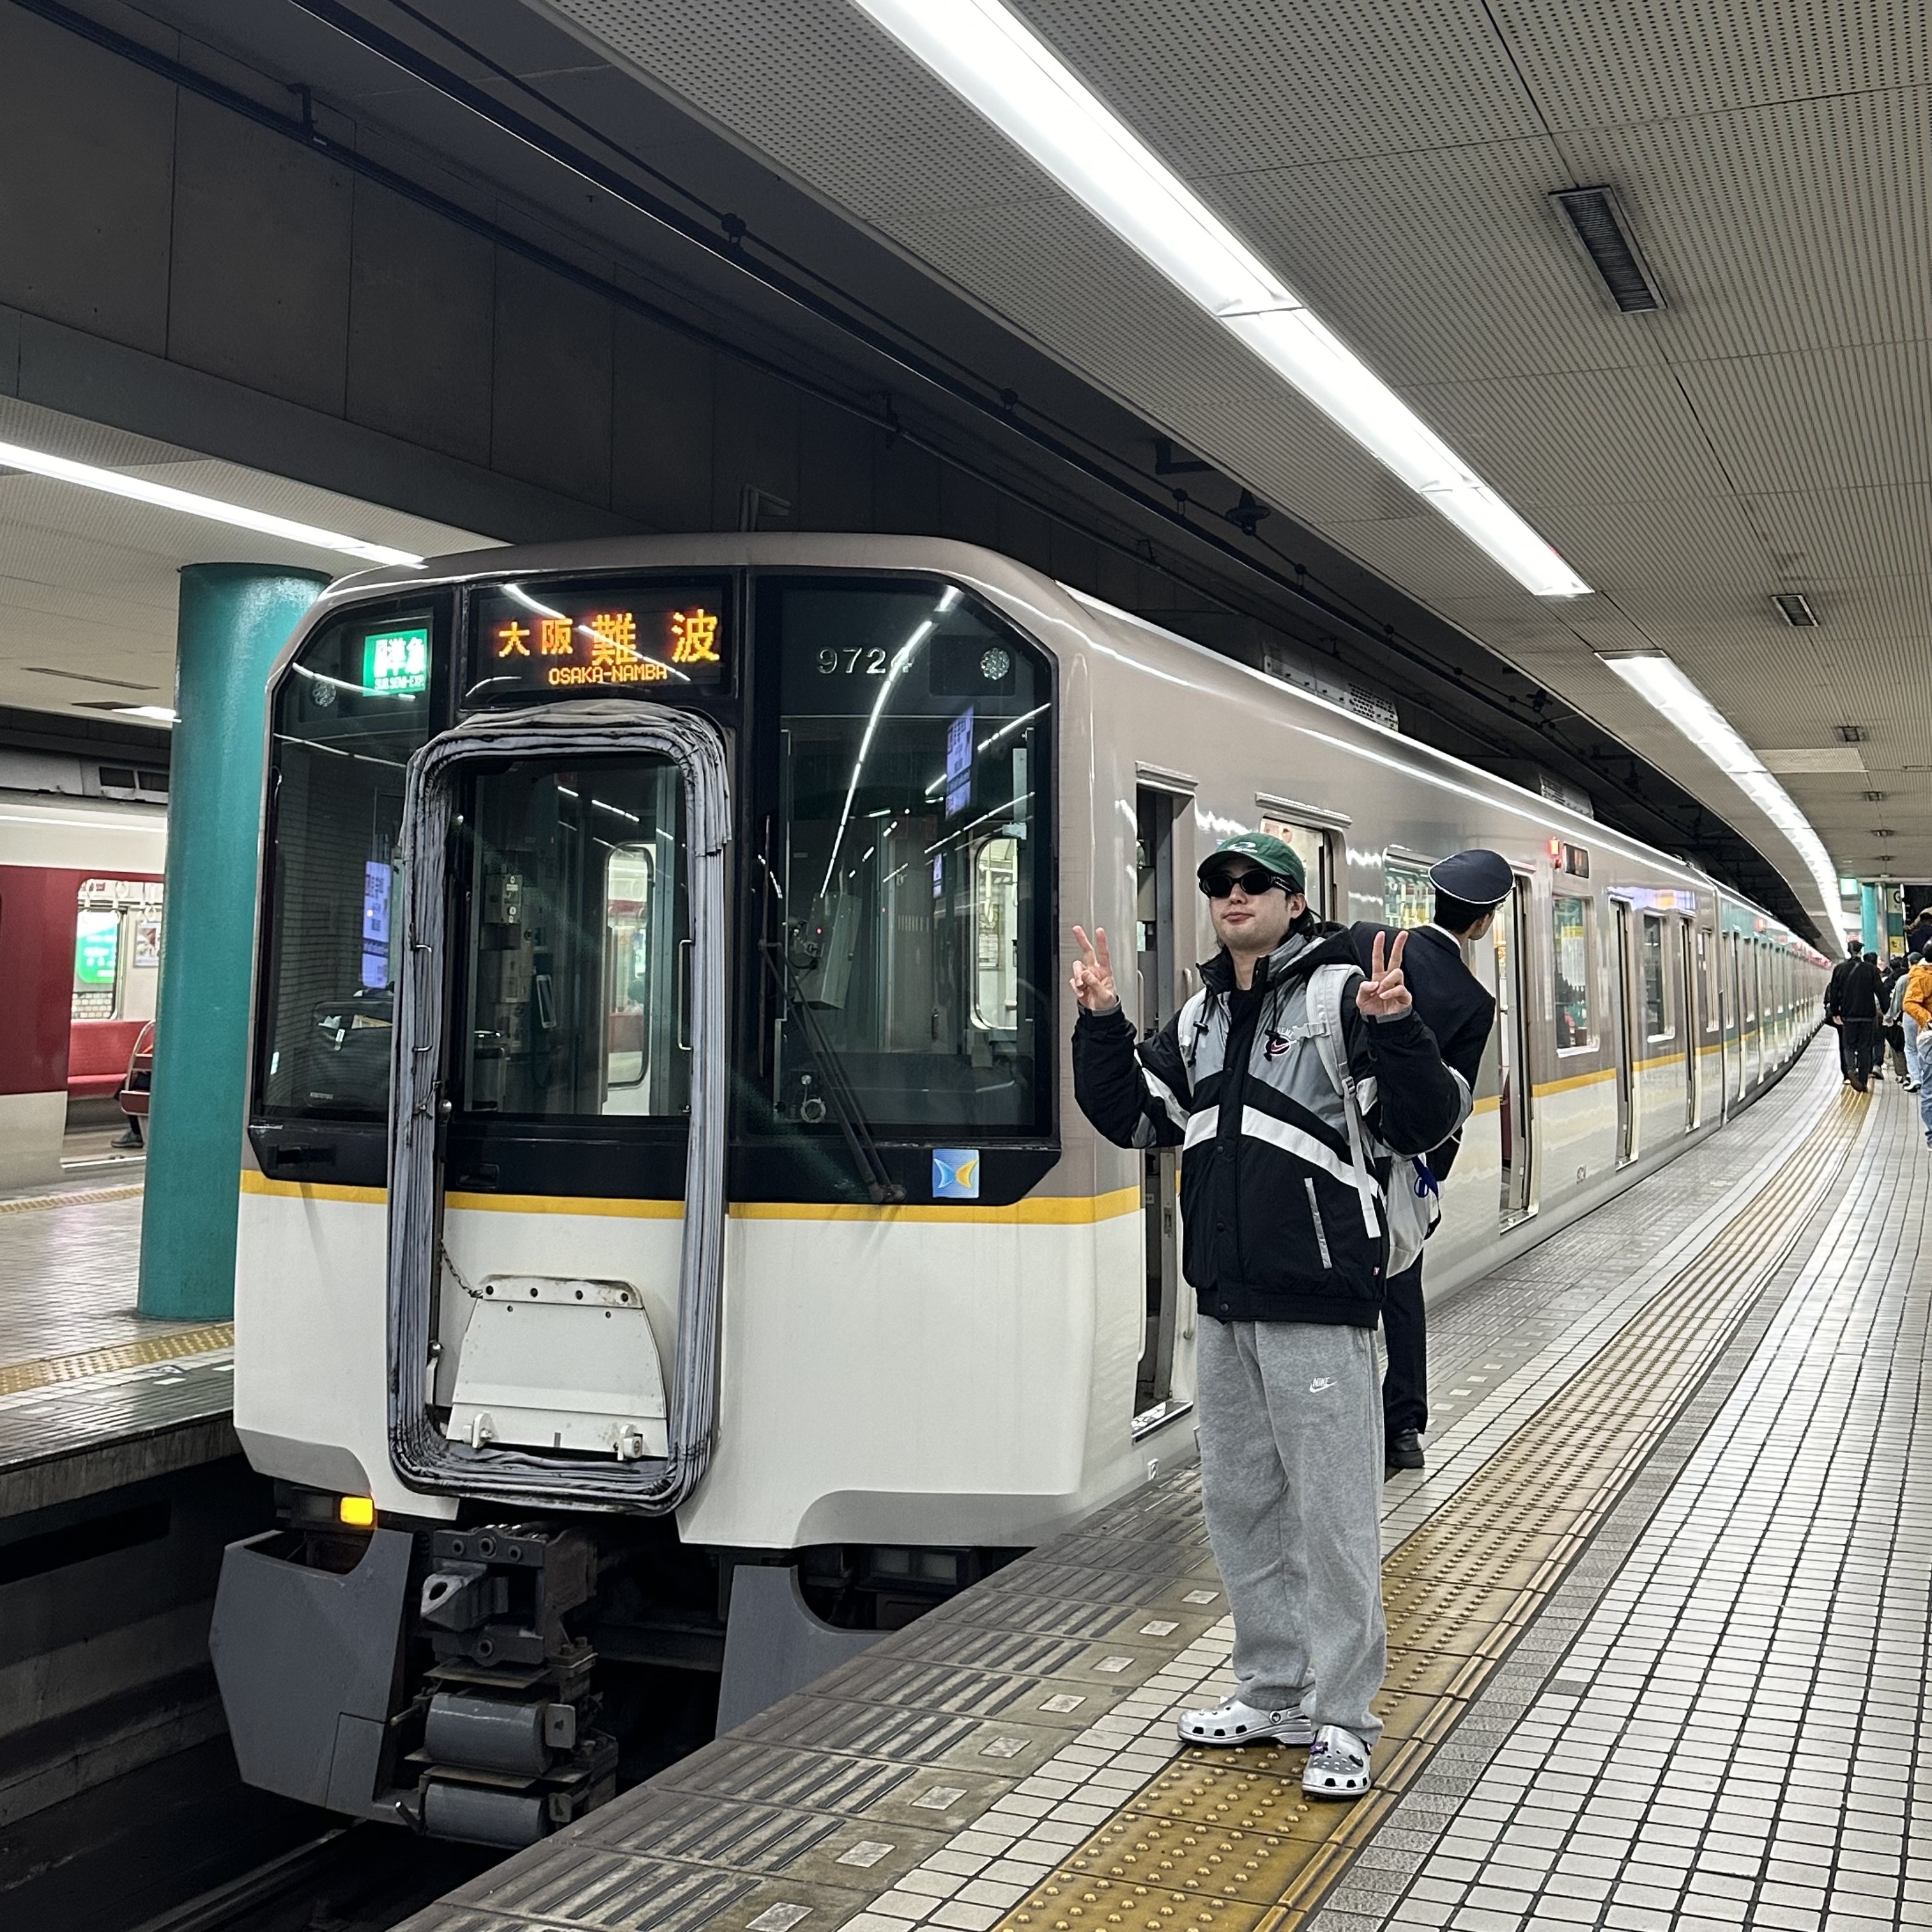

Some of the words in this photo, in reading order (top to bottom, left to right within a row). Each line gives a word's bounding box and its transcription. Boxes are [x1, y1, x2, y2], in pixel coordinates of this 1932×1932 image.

[498, 608, 720, 666] 大阪難波
[548, 663, 668, 684] OSAKA-NAMBA
